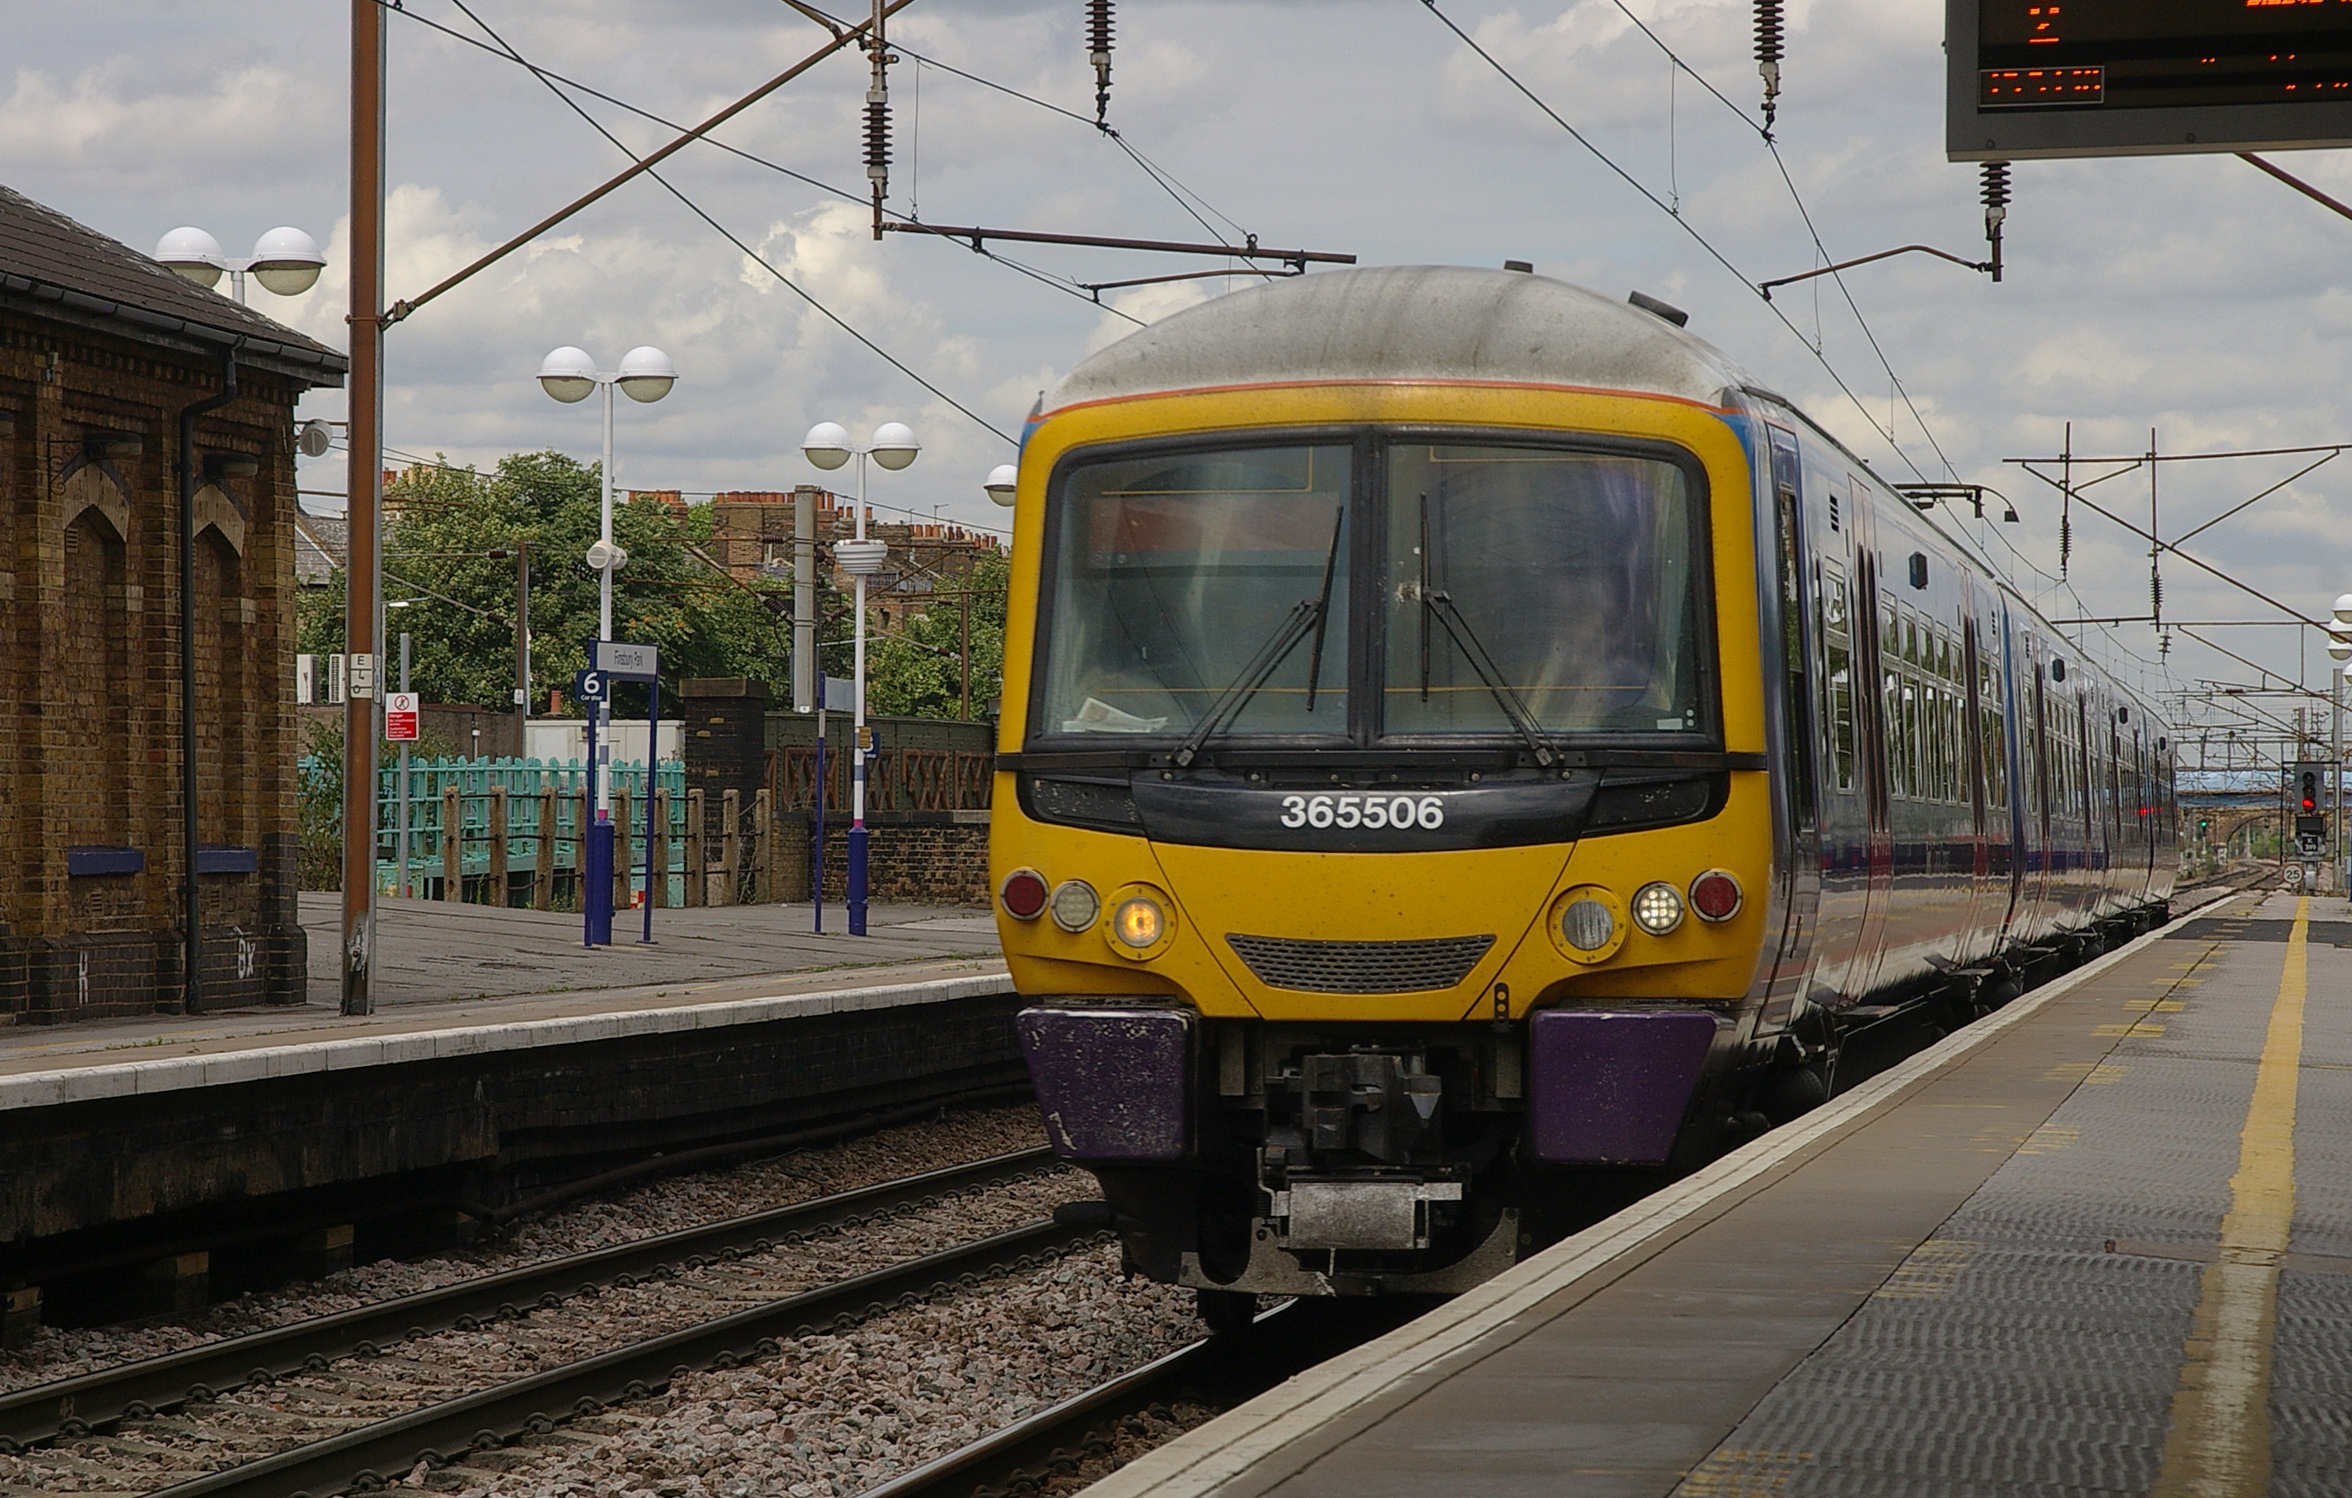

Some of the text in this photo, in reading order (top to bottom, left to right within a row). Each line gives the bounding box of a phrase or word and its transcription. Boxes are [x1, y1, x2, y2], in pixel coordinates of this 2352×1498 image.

[584, 672, 600, 694] 6
[1280, 796, 1444, 829] 365506
[2286, 869, 2300, 880] 25
